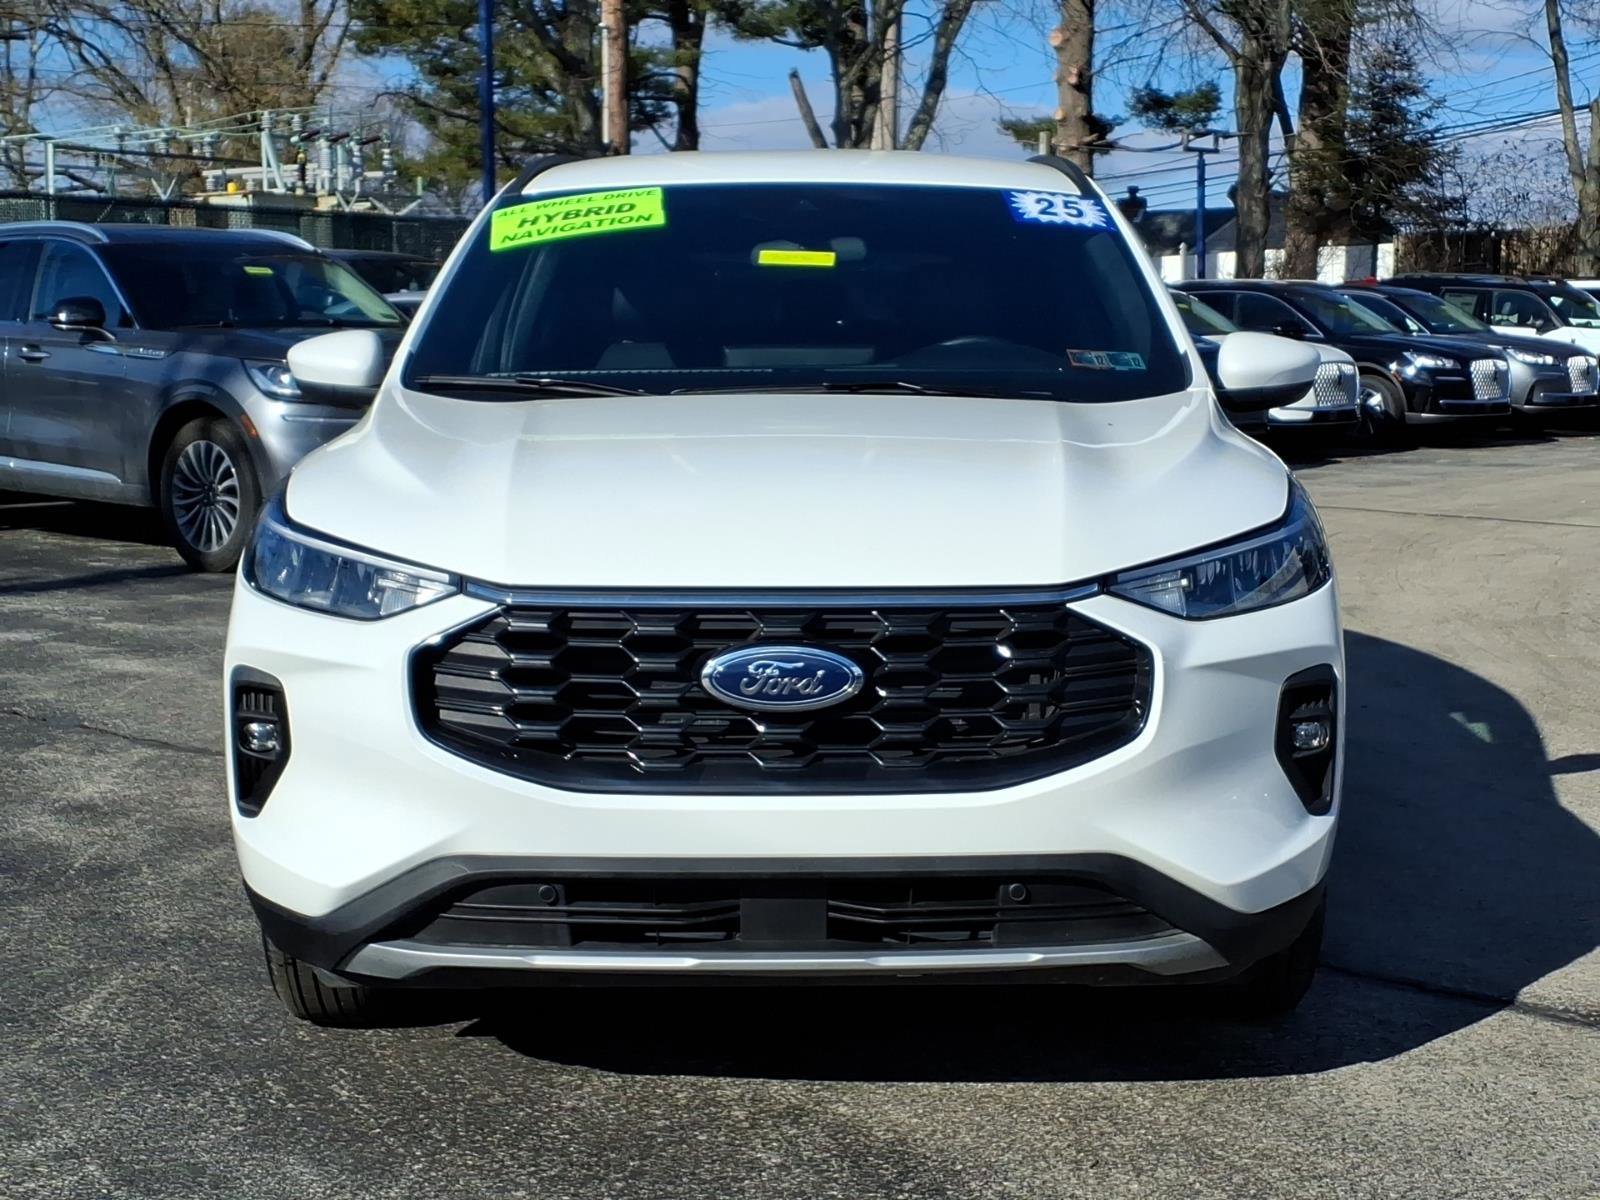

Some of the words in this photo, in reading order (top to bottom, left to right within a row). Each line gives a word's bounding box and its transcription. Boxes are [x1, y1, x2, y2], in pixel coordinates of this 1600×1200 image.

[497, 206, 529, 218] ALL
[536, 195, 597, 210] WHEEL
[603, 189, 658, 200] DRIVE
[517, 202, 637, 229] HYBRID
[1034, 197, 1084, 218] 25
[500, 213, 654, 243] NAVIGATION
[739, 660, 826, 696] Ford
